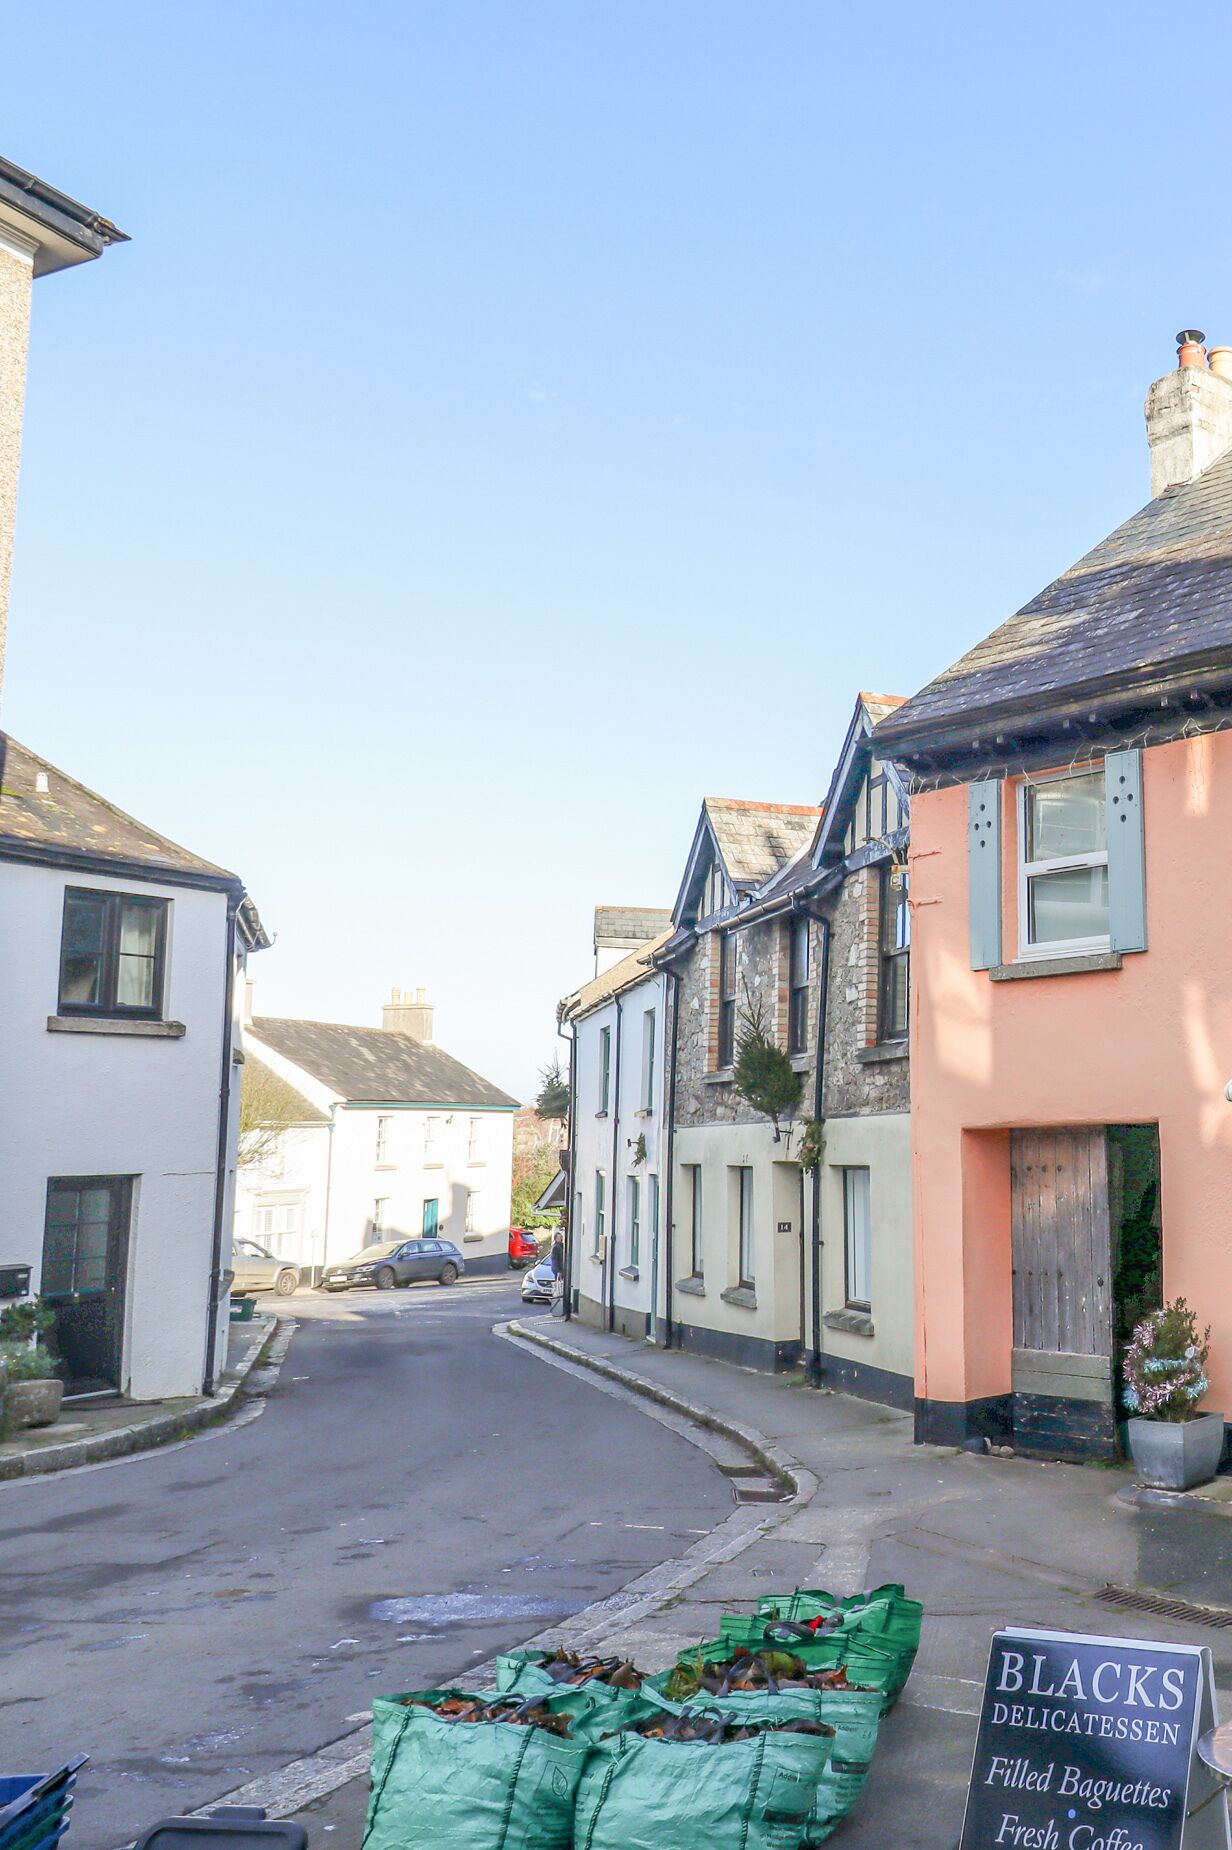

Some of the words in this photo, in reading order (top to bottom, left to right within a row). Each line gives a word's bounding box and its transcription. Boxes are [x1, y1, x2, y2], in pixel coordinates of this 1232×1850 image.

[995, 1651, 1185, 1711] BLACKS
[991, 1702, 1181, 1746] DELICATESSEN
[984, 1756, 1054, 1793] Filled
[1057, 1765, 1171, 1809] Baguettes
[994, 1813, 1059, 1850] Fresh
